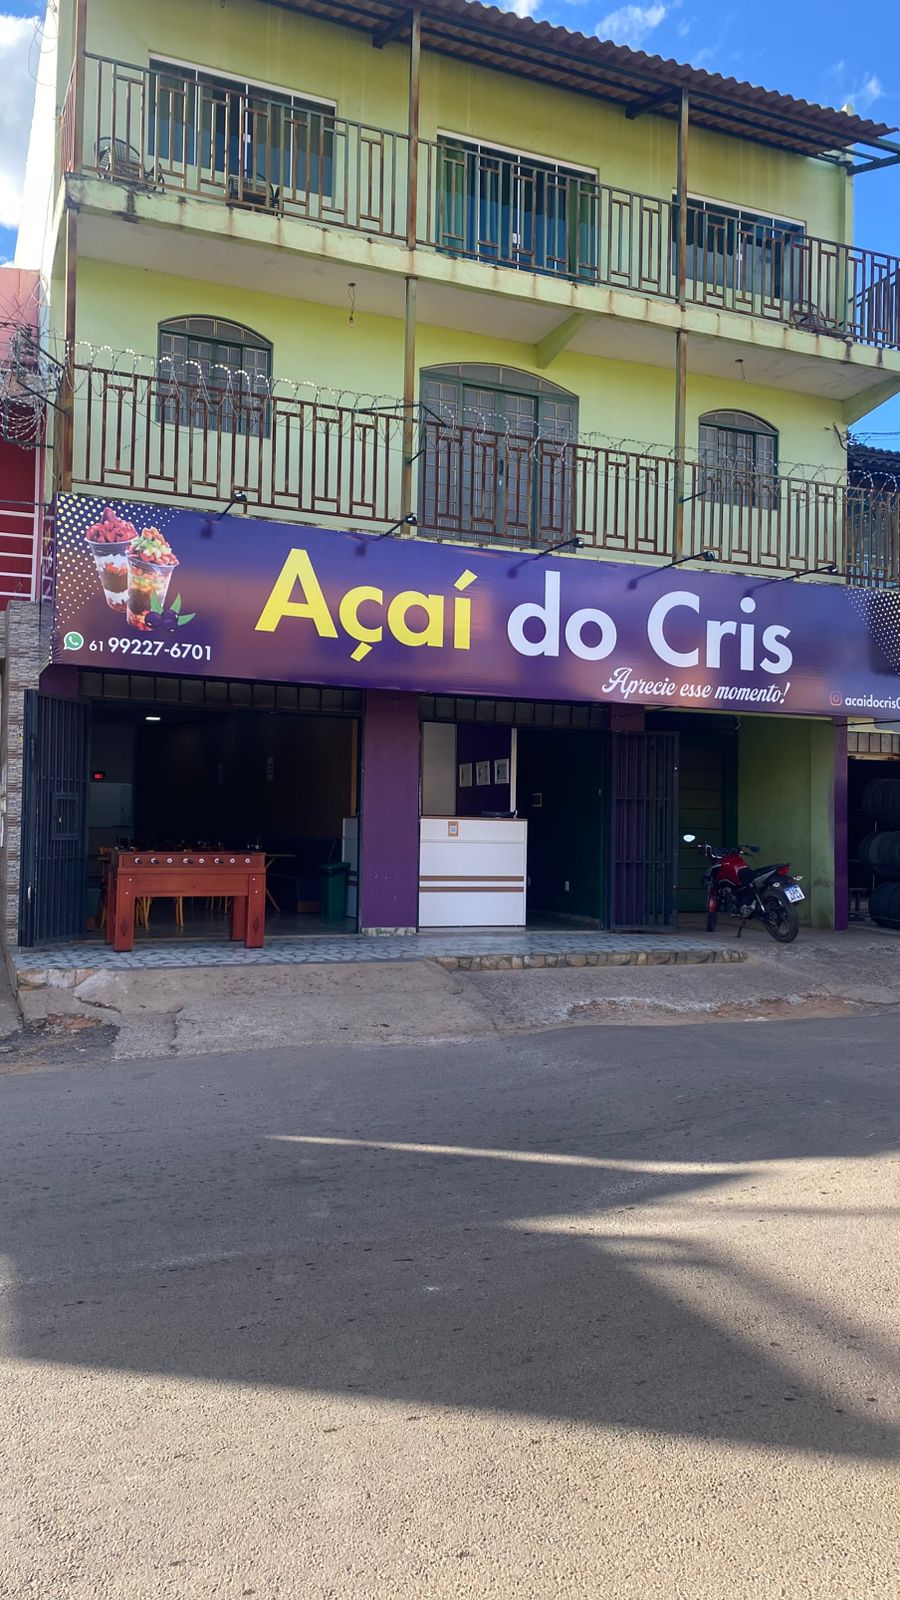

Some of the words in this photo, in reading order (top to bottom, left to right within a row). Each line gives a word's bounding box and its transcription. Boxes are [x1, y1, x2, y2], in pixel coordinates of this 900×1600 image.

[254, 547, 478, 662] Açaí
[507, 570, 617, 661] do
[647, 591, 793, 674] Cris
[89, 640, 104, 652] 61
[108, 637, 211, 661] 99227-6701
[602, 666, 677, 700] Aprecie
[679, 682, 713, 698] esse
[714, 682, 791, 705] momento!
